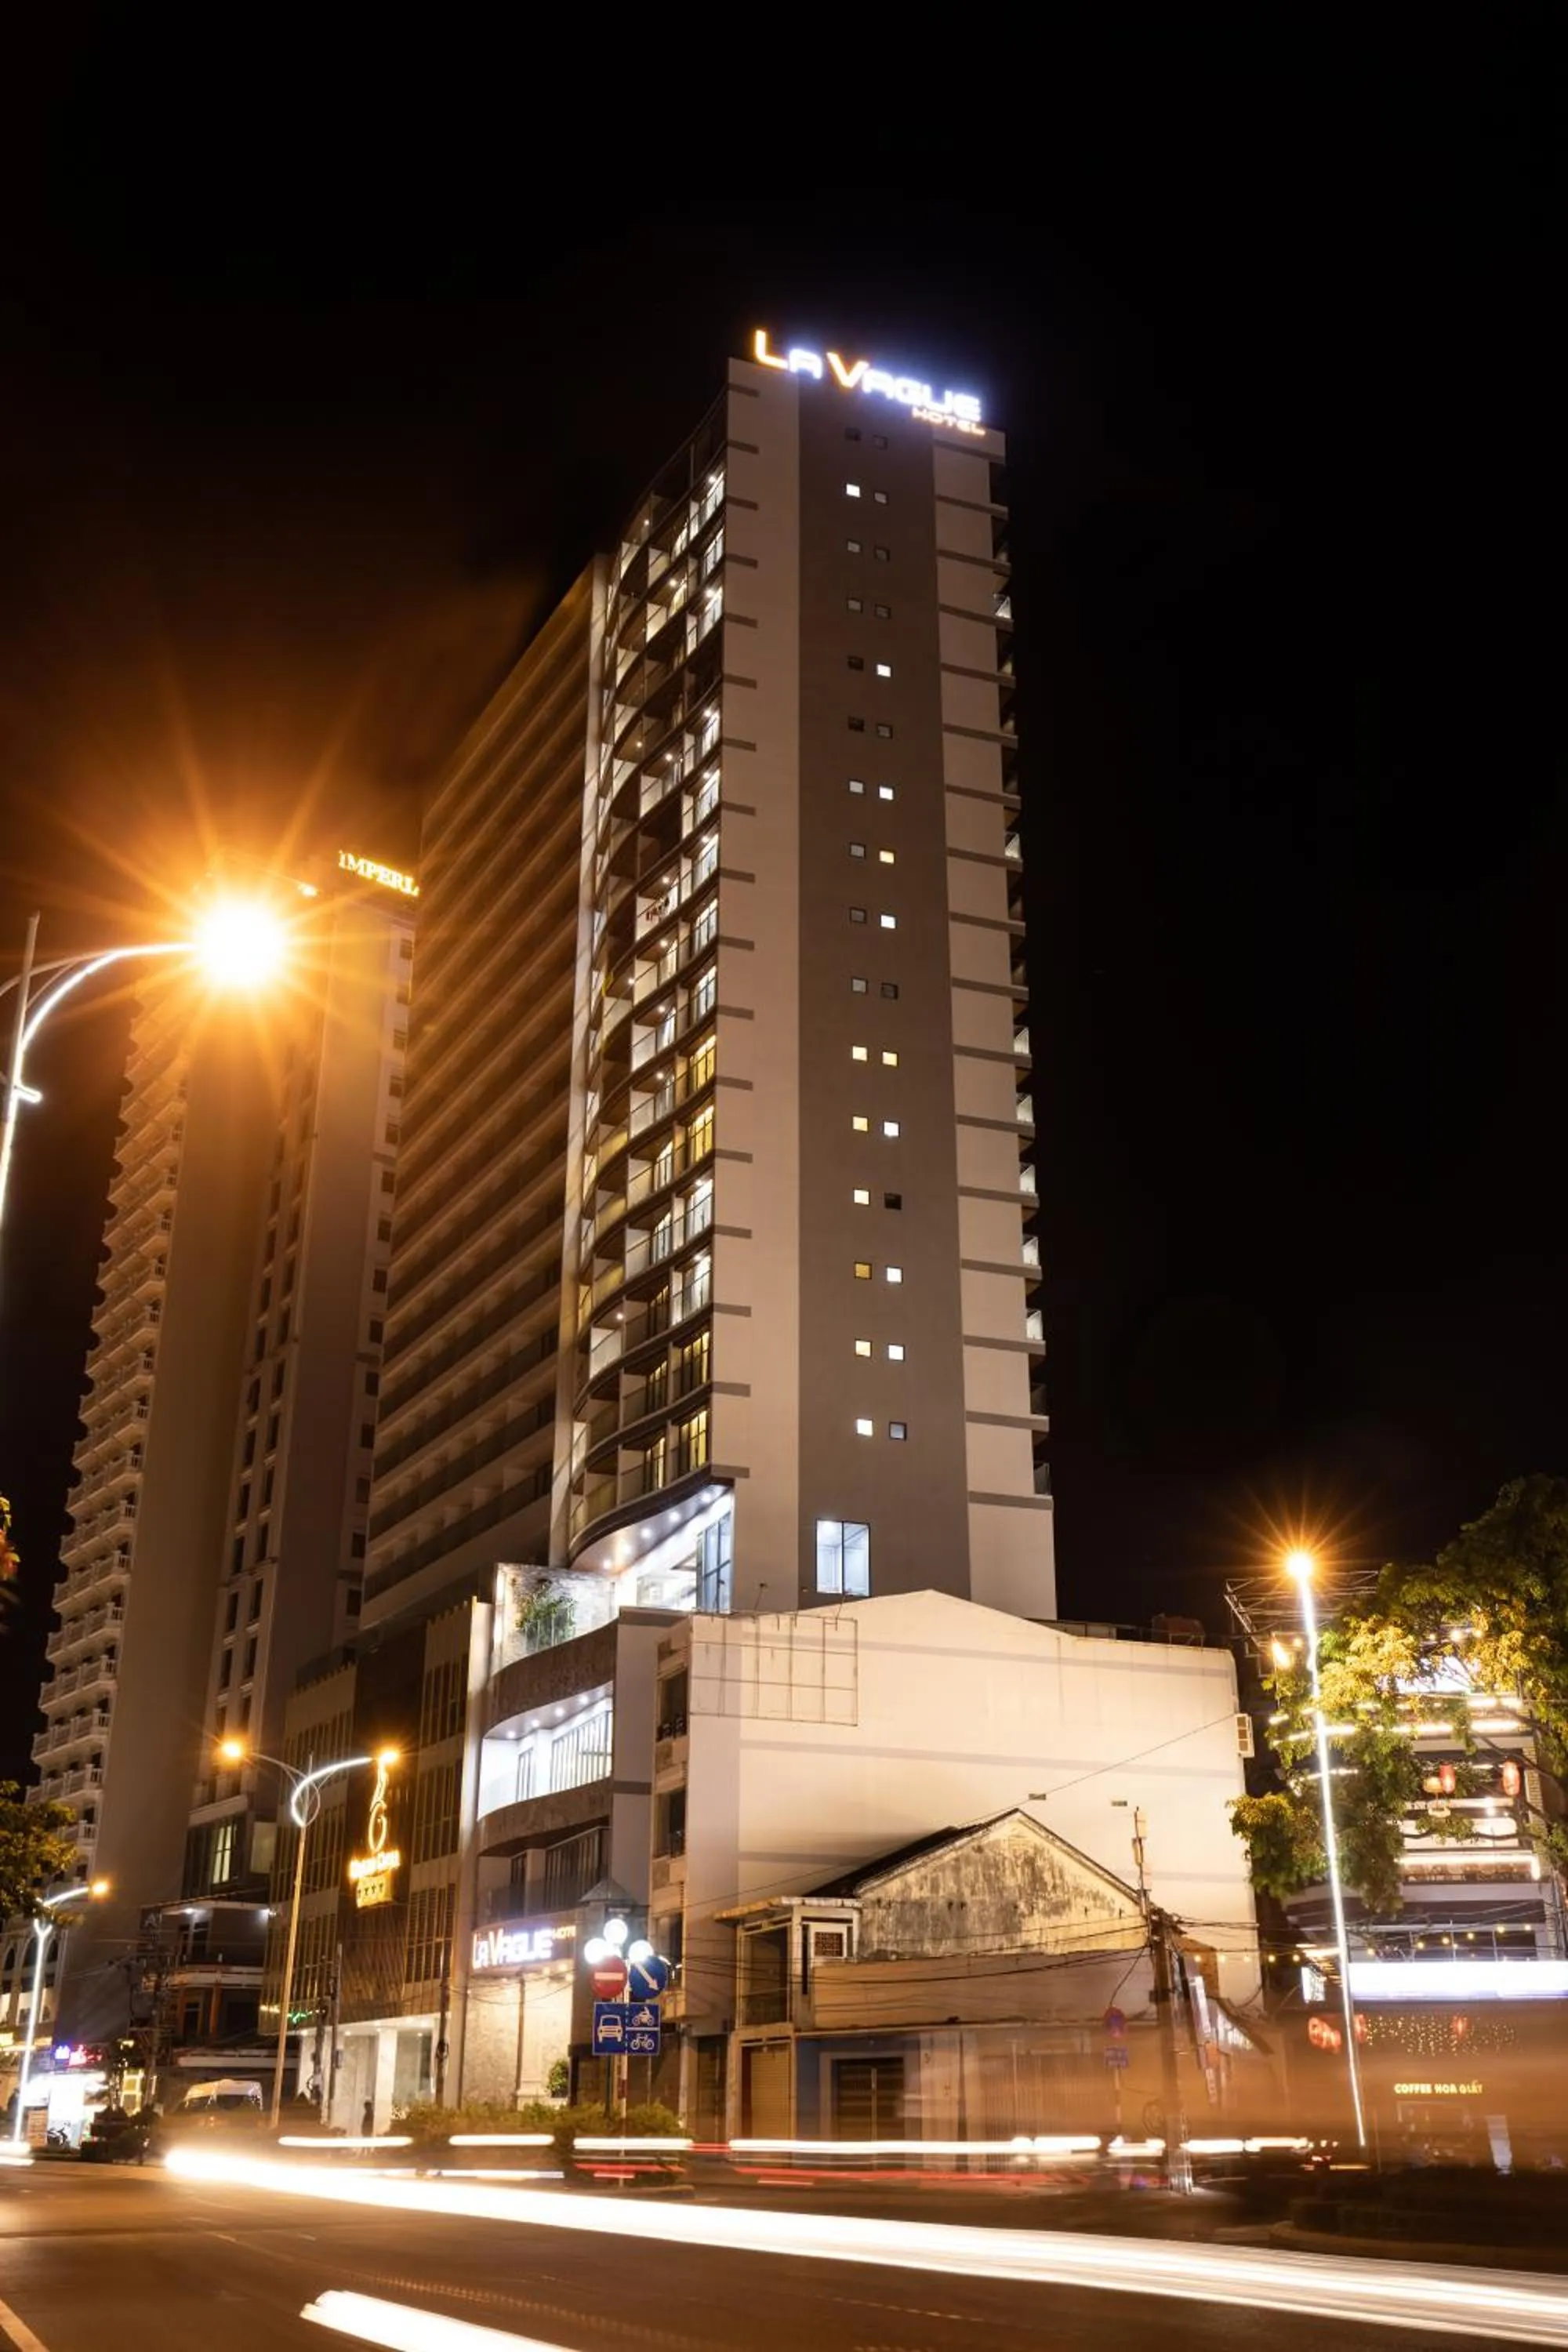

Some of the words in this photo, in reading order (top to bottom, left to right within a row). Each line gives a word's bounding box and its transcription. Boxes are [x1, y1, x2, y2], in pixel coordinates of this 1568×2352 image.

[754, 329, 822, 379] LA
[826, 352, 982, 422] VAGUE
[912, 407, 985, 435] HOTEL
[1394, 2083, 1432, 2094] COFFEE
